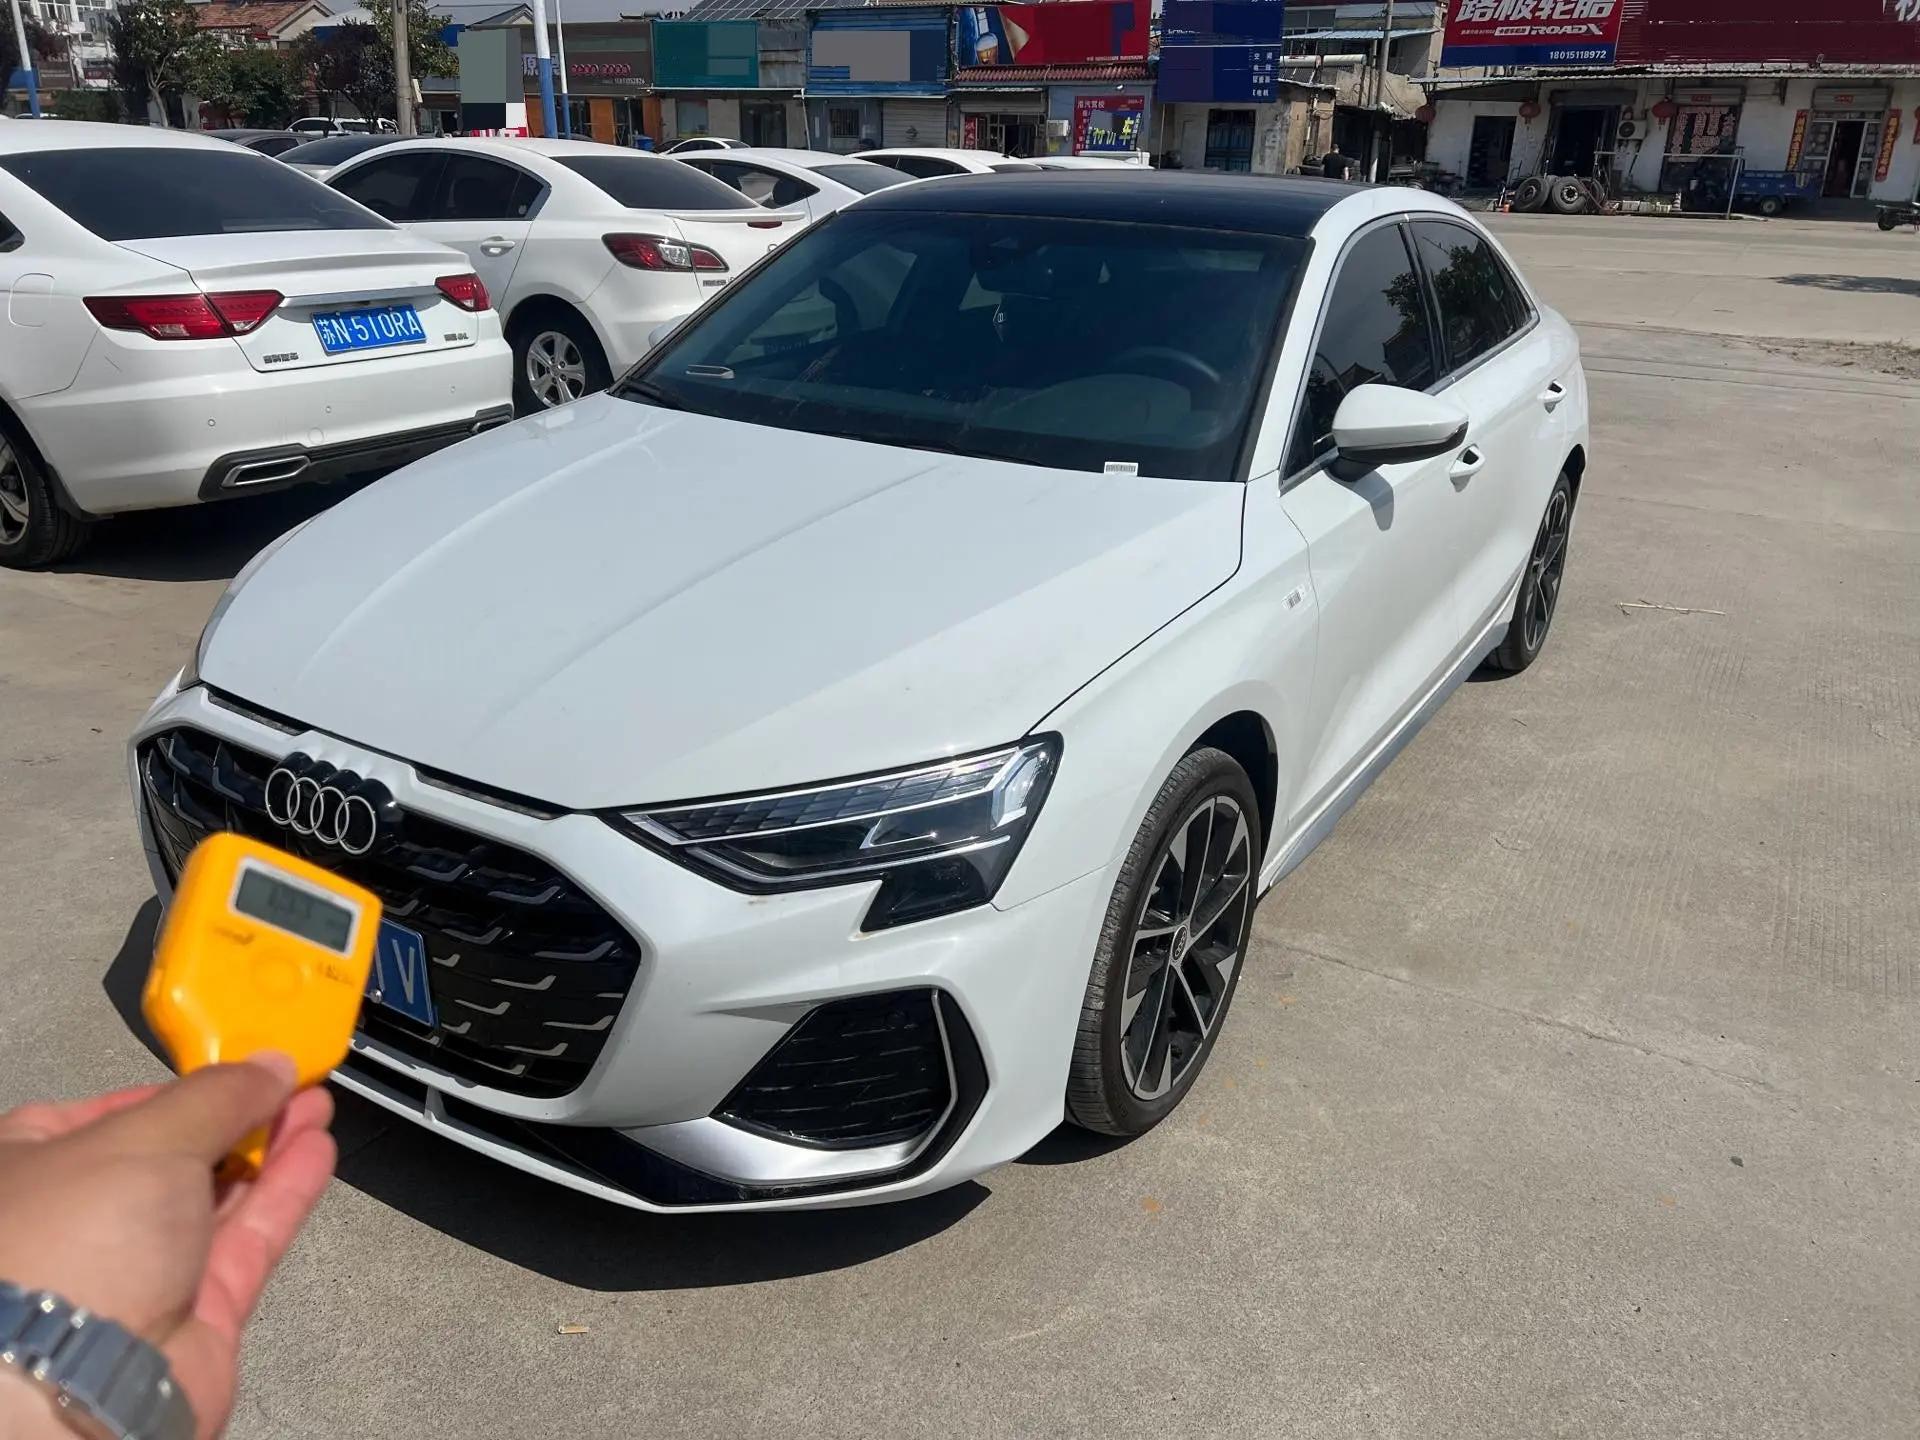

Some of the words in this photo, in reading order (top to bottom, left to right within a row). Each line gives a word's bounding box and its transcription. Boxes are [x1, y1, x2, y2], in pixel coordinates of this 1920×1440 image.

[1455, 0, 1615, 22] 路极轮胎
[1532, 23, 1605, 35] ROADX
[1550, 50, 1606, 60] 18015118972
